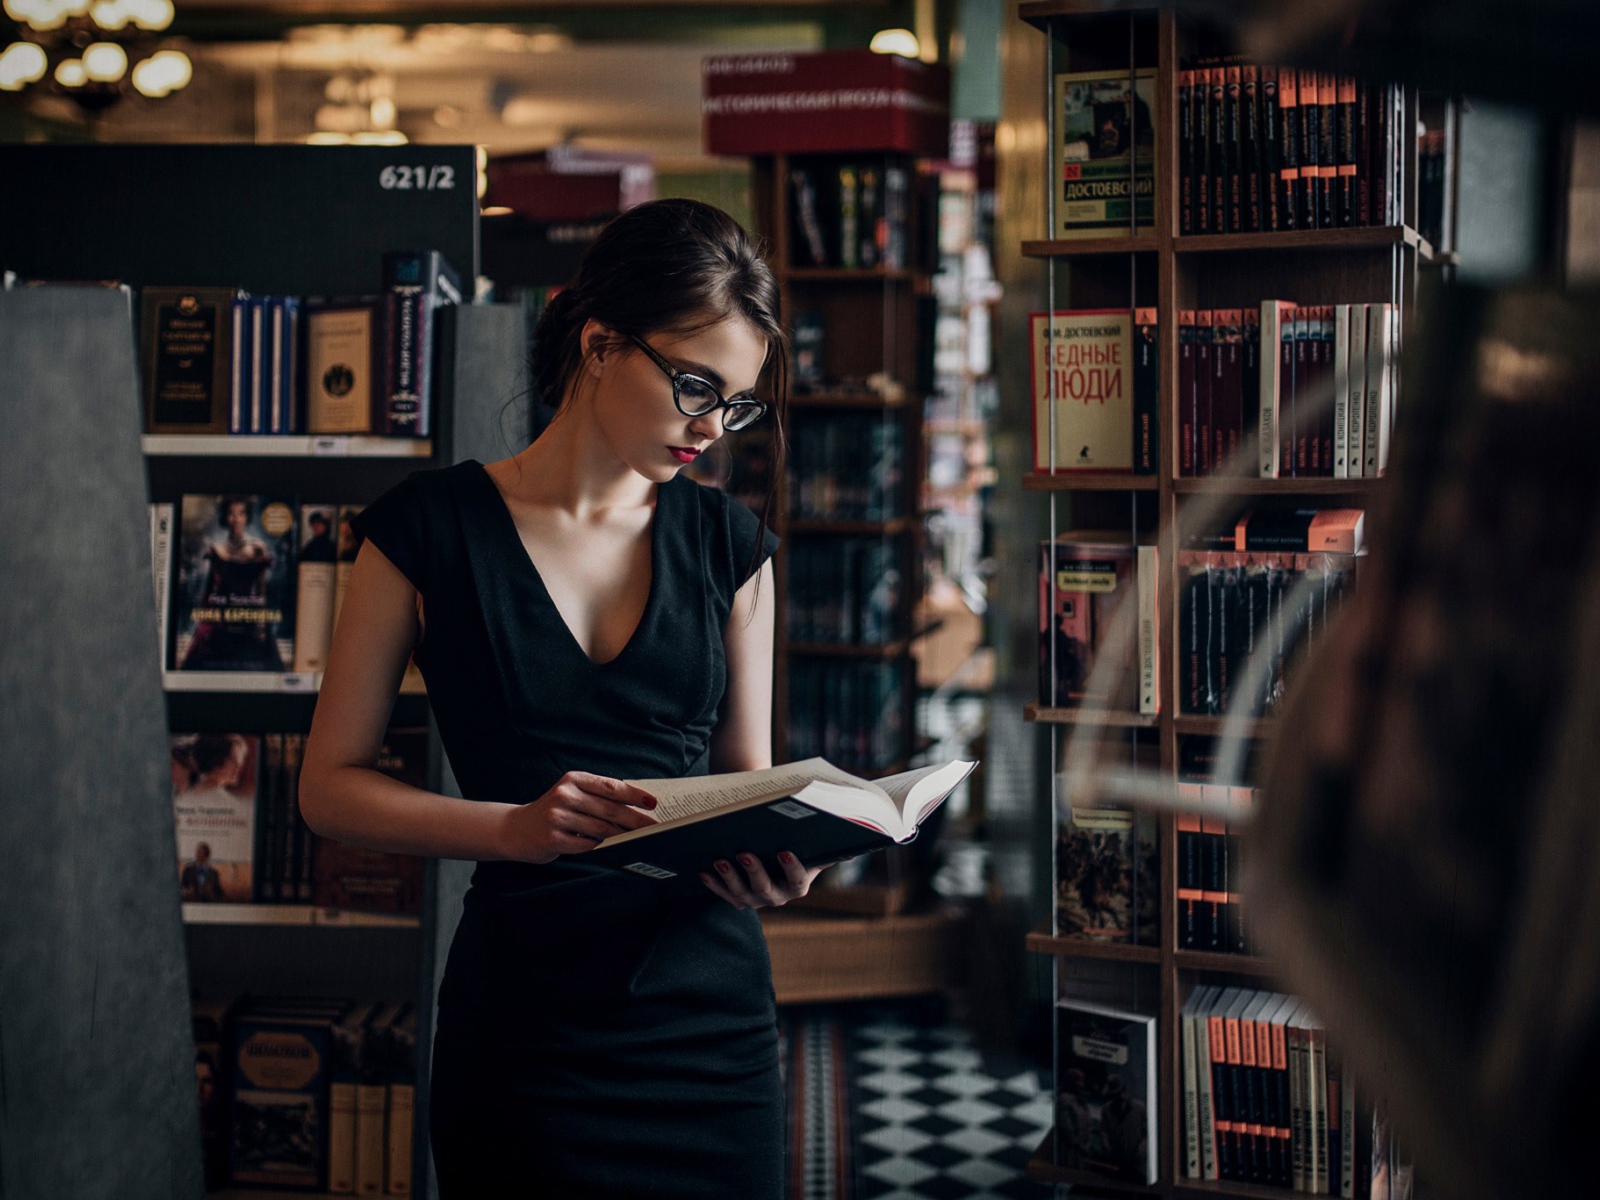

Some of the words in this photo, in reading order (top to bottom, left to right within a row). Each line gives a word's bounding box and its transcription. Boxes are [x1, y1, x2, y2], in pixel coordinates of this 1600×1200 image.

[379, 165, 456, 191] 621/2
[1064, 324, 1120, 339] ДОСТОЕВСКИЙ
[1043, 368, 1122, 404] ЛЮДИ
